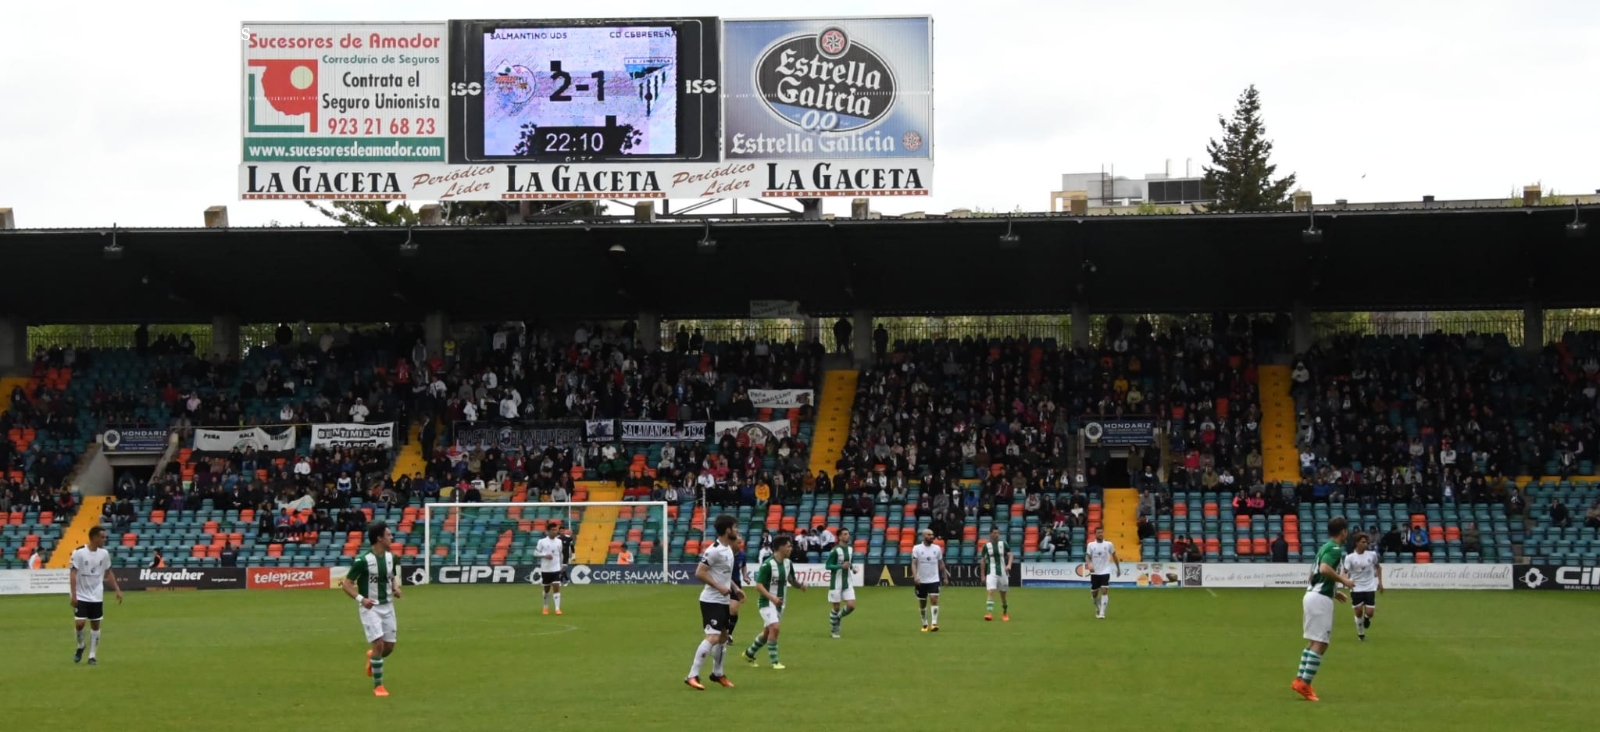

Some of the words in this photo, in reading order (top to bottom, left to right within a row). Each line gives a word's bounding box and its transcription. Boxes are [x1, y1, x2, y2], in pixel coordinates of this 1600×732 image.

[248, 33, 334, 48] Sucesores
[340, 33, 362, 48] de
[370, 33, 440, 48] Amador
[322, 54, 377, 64] Correduría
[384, 55, 395, 64] de
[399, 55, 440, 66] Seguros
[775, 49, 881, 90] Estrella
[343, 72, 403, 87] Contrata
[408, 71, 420, 87] el
[686, 79, 717, 94] ISO
[322, 93, 370, 113] Seguro
[375, 93, 440, 109] Unionista
[777, 77, 870, 116] Galicia
[328, 118, 358, 135] 923
[364, 118, 381, 134] 21
[390, 118, 410, 134] 68
[416, 118, 435, 134] 23
[249, 141, 441, 157] www.sucesoresdeamador.com
[545, 133, 604, 151] 22:10
[731, 132, 813, 153] Estrella
[819, 131, 895, 152] Galicia
[247, 165, 285, 193] LA
[292, 165, 402, 193] GACETA
[412, 166, 495, 189] Periódico
[507, 165, 544, 192] LA
[552, 165, 661, 192] GACETA
[672, 163, 755, 188] Periódico
[767, 163, 805, 190] LA
[813, 162, 923, 190] GACETA
[440, 181, 490, 199] Líder
[700, 179, 750, 197] Líder
[318, 427, 391, 439] SENTIMIENTO
[622, 424, 671, 437] SALAMANCA
[687, 424, 705, 437] 1923
[140, 568, 204, 585] Hergaher
[254, 571, 313, 586] telepizza
[593, 571, 621, 580] COPE
[624, 571, 690, 580] SALAMANCA
[1025, 566, 1072, 576] Herrero
[1410, 566, 1455, 580] balneario
[1458, 566, 1469, 579] de
[1472, 565, 1509, 579] ciudad!
